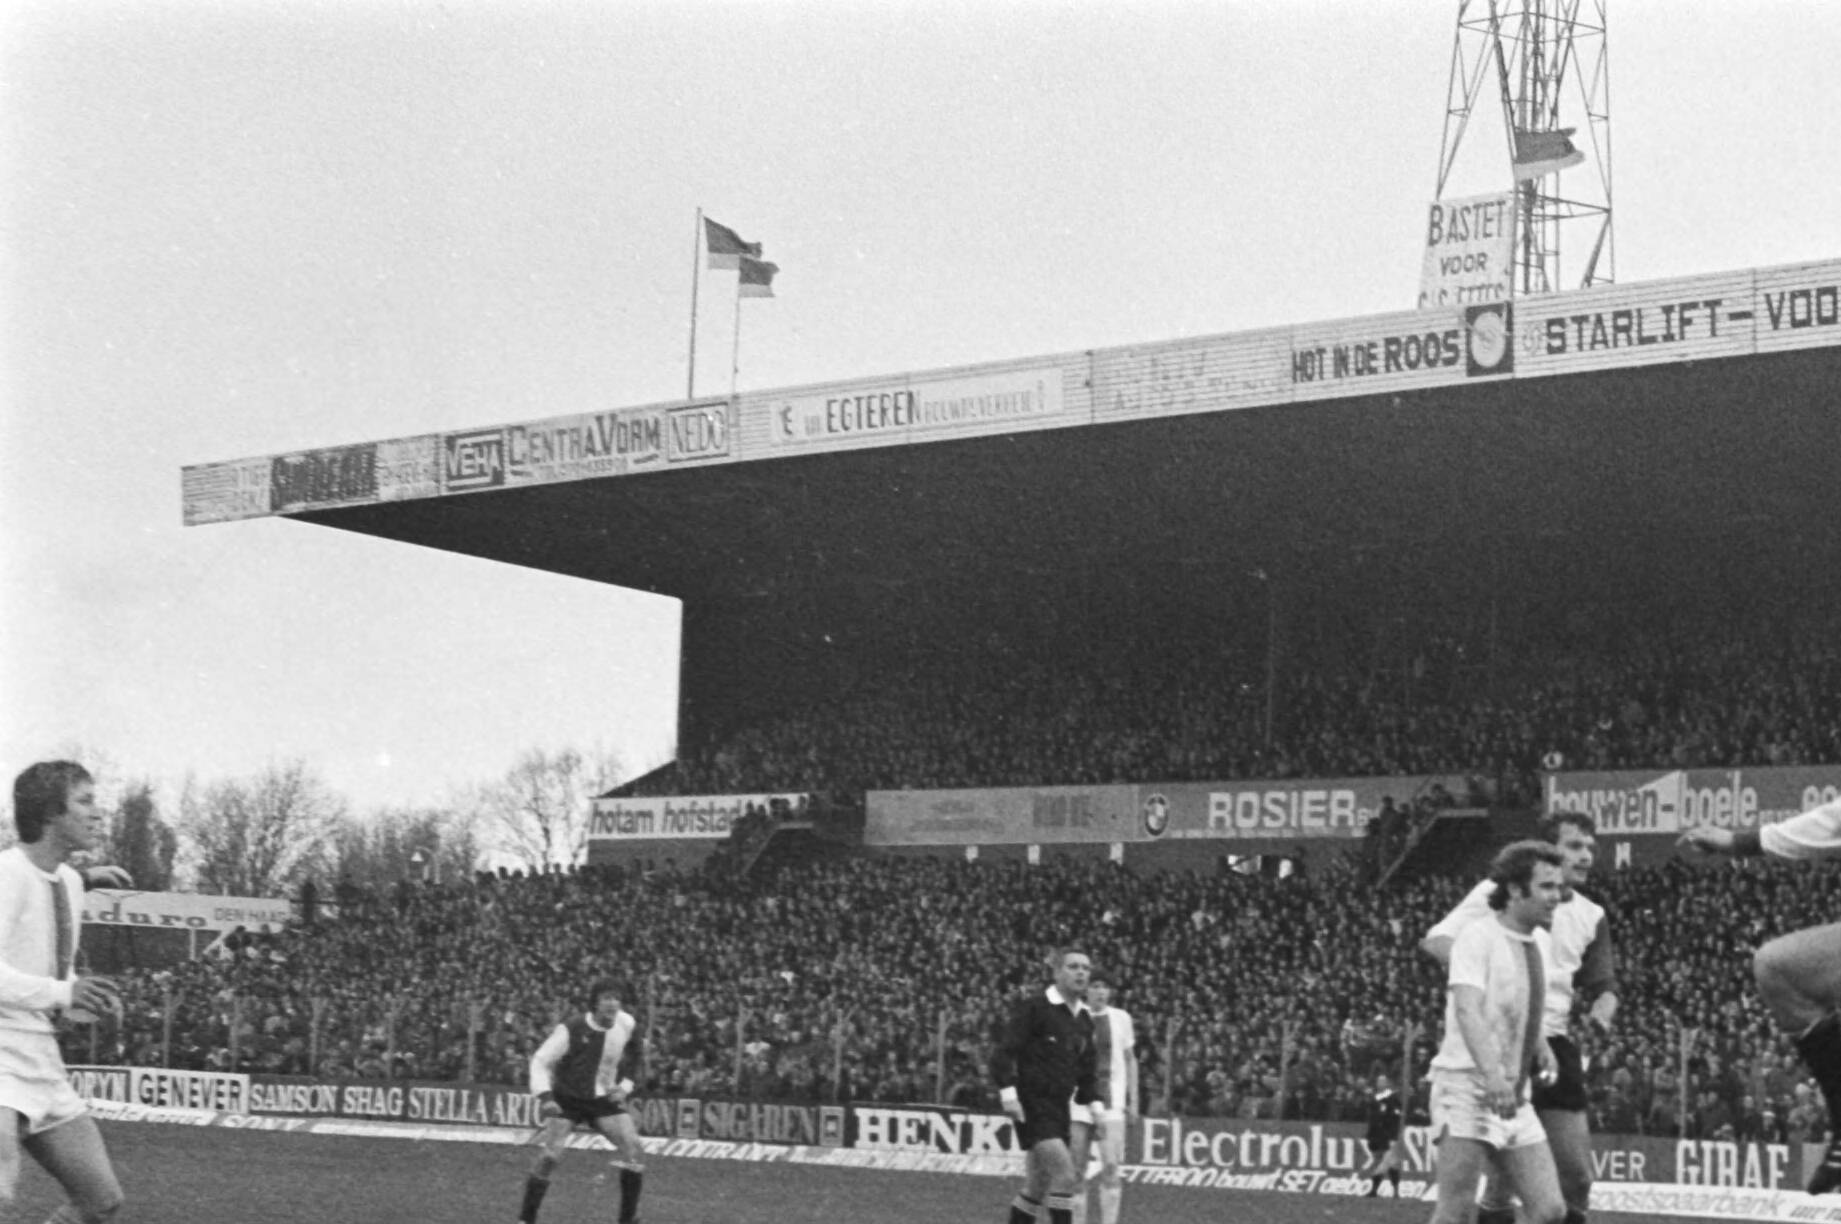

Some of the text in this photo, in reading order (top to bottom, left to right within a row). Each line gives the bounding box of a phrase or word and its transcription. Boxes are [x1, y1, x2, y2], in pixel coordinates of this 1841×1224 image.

[1440, 252, 1488, 276] VOOR
[1354, 342, 1378, 376] DE
[1384, 330, 1459, 373] ROOS
[1208, 790, 1355, 828] ROSIER
[139, 1073, 243, 1112] GENEVER
[250, 1083, 403, 1116] SAMSON SHAG
[407, 1087, 488, 1123] STELLA
[854, 1107, 1021, 1152] HENK
[1590, 1150, 1647, 1181] VER
